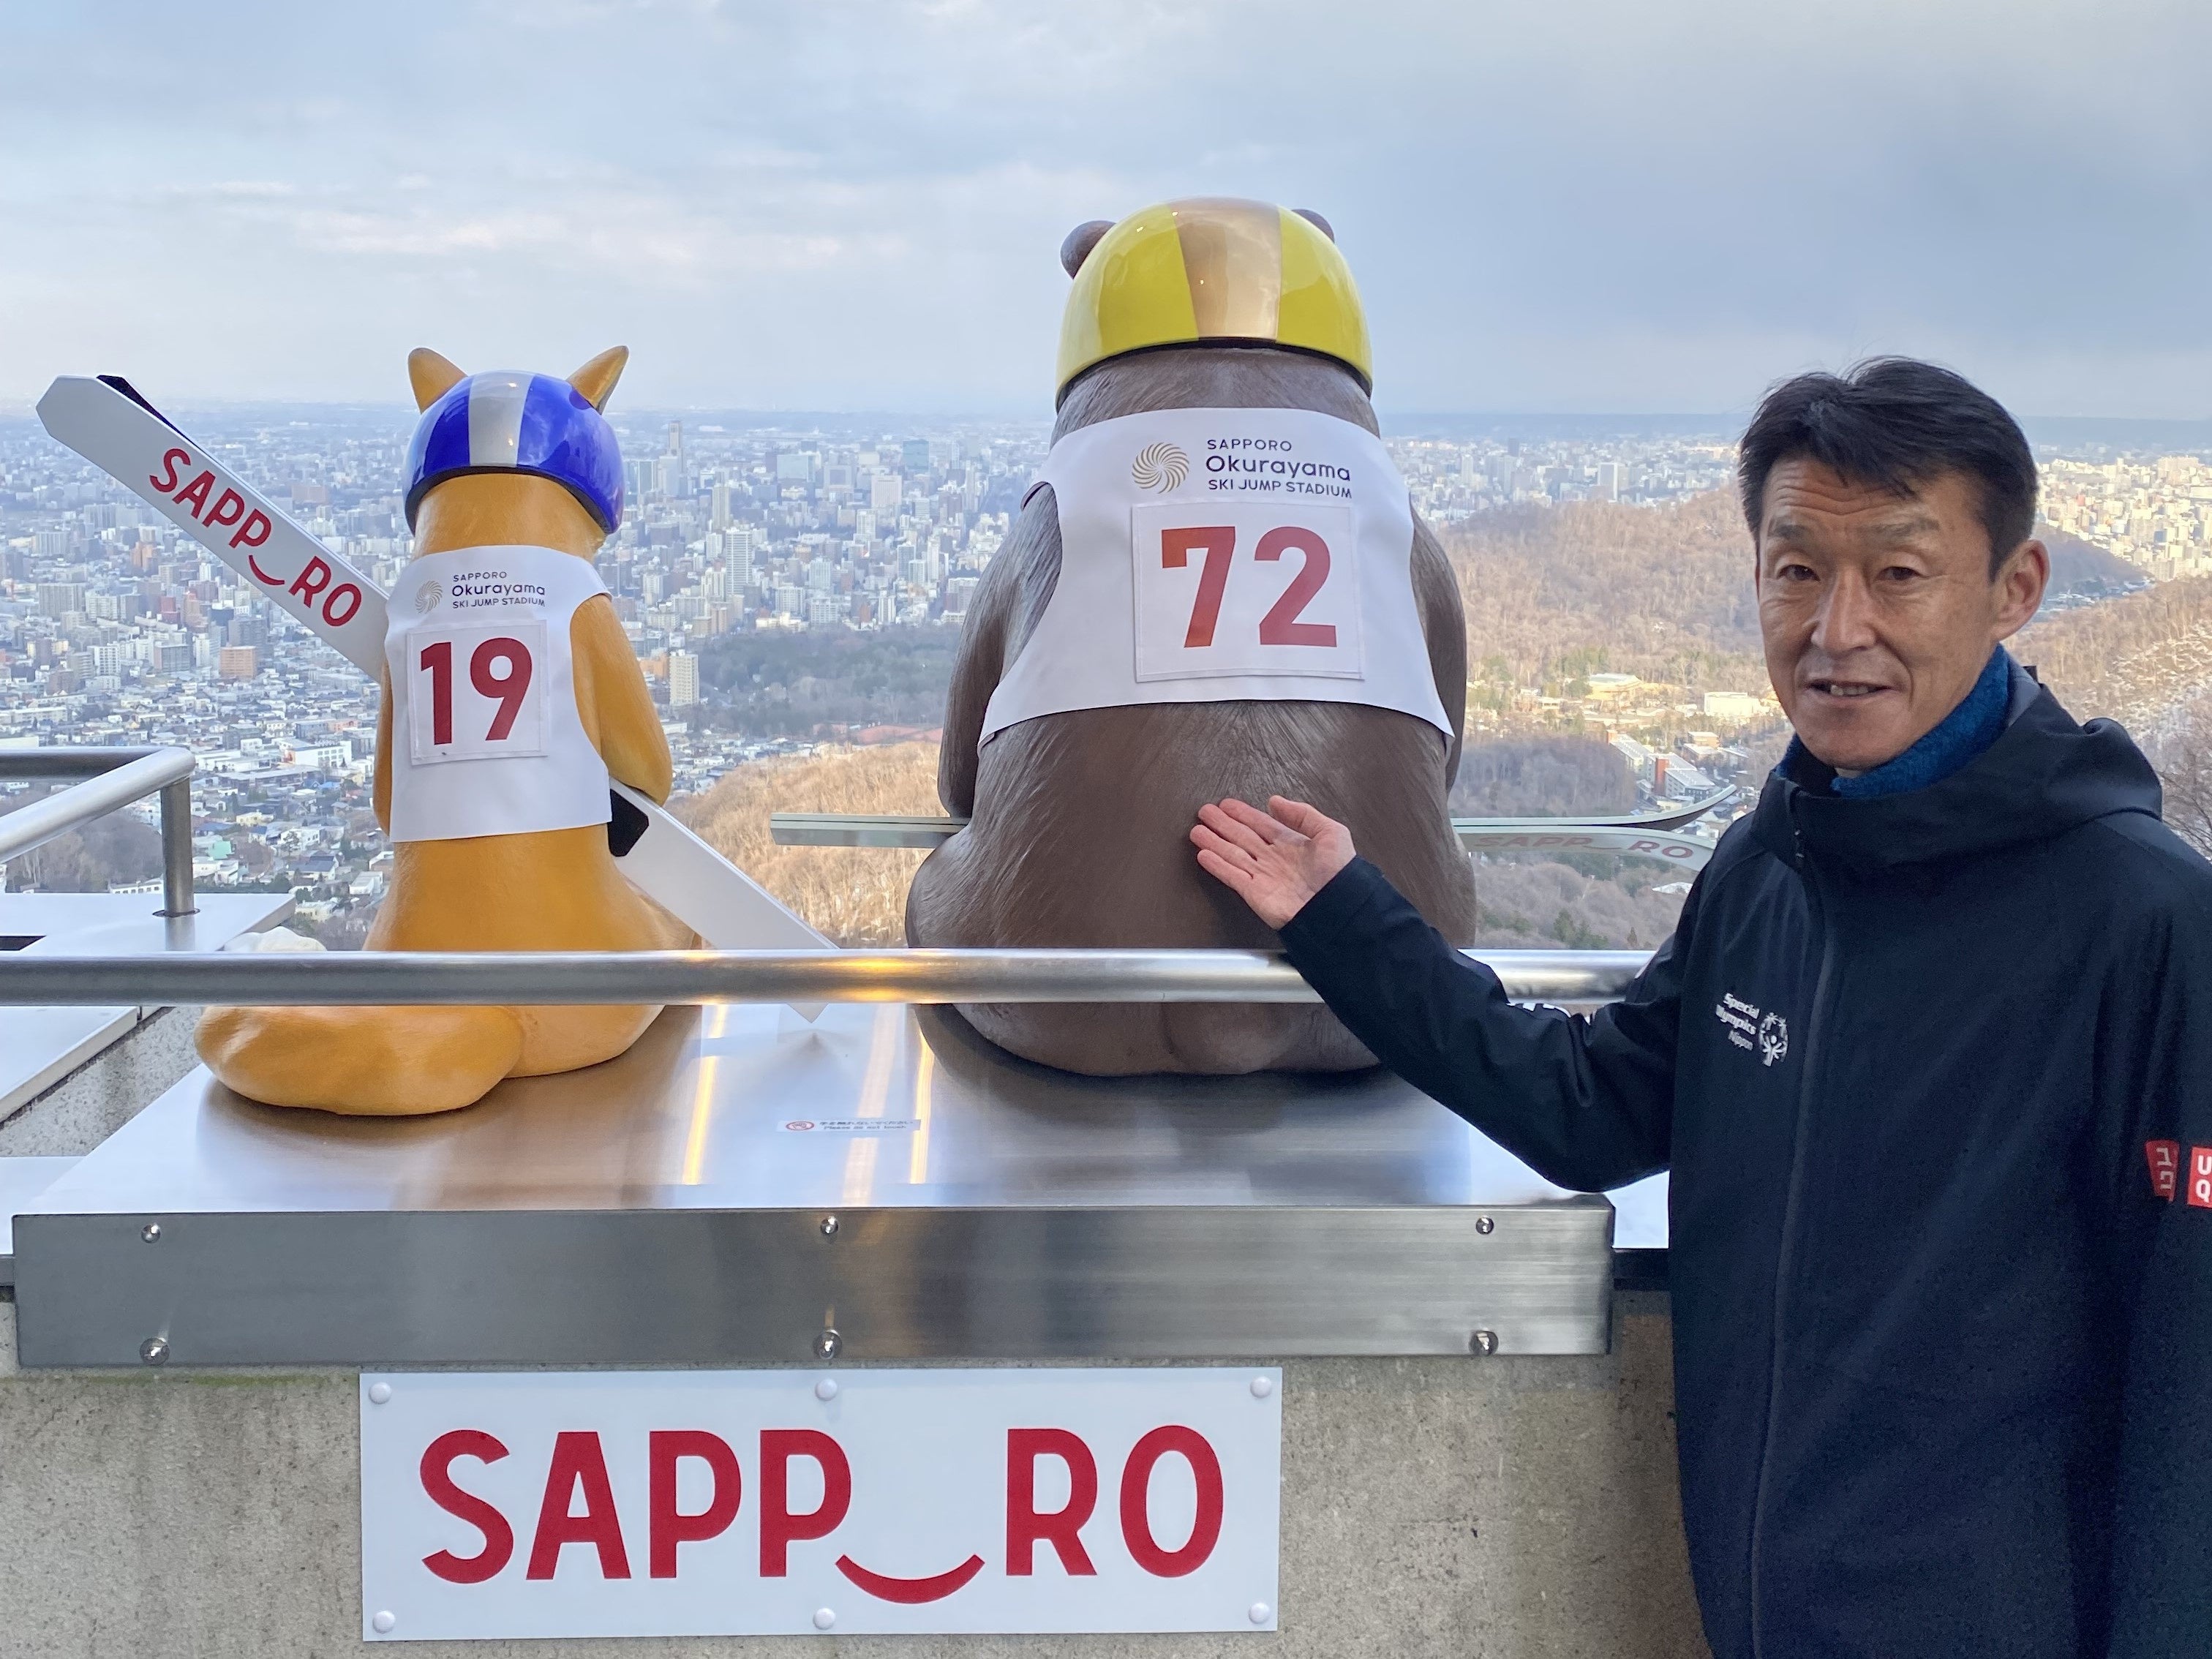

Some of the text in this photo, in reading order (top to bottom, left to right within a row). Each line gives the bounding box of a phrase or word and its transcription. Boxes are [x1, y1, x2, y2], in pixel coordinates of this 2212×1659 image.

[1206, 438, 1293, 452] SAPPORO
[1205, 455, 1351, 481] Okurayama
[1208, 479, 1353, 499] SKI JUMP STADIUM
[453, 571, 508, 582] SAPPORO
[451, 583, 546, 597] Okurayama
[1161, 526, 1338, 649] 72
[452, 597, 546, 609] SKI JUMP STADIUM
[421, 637, 533, 745] 19
